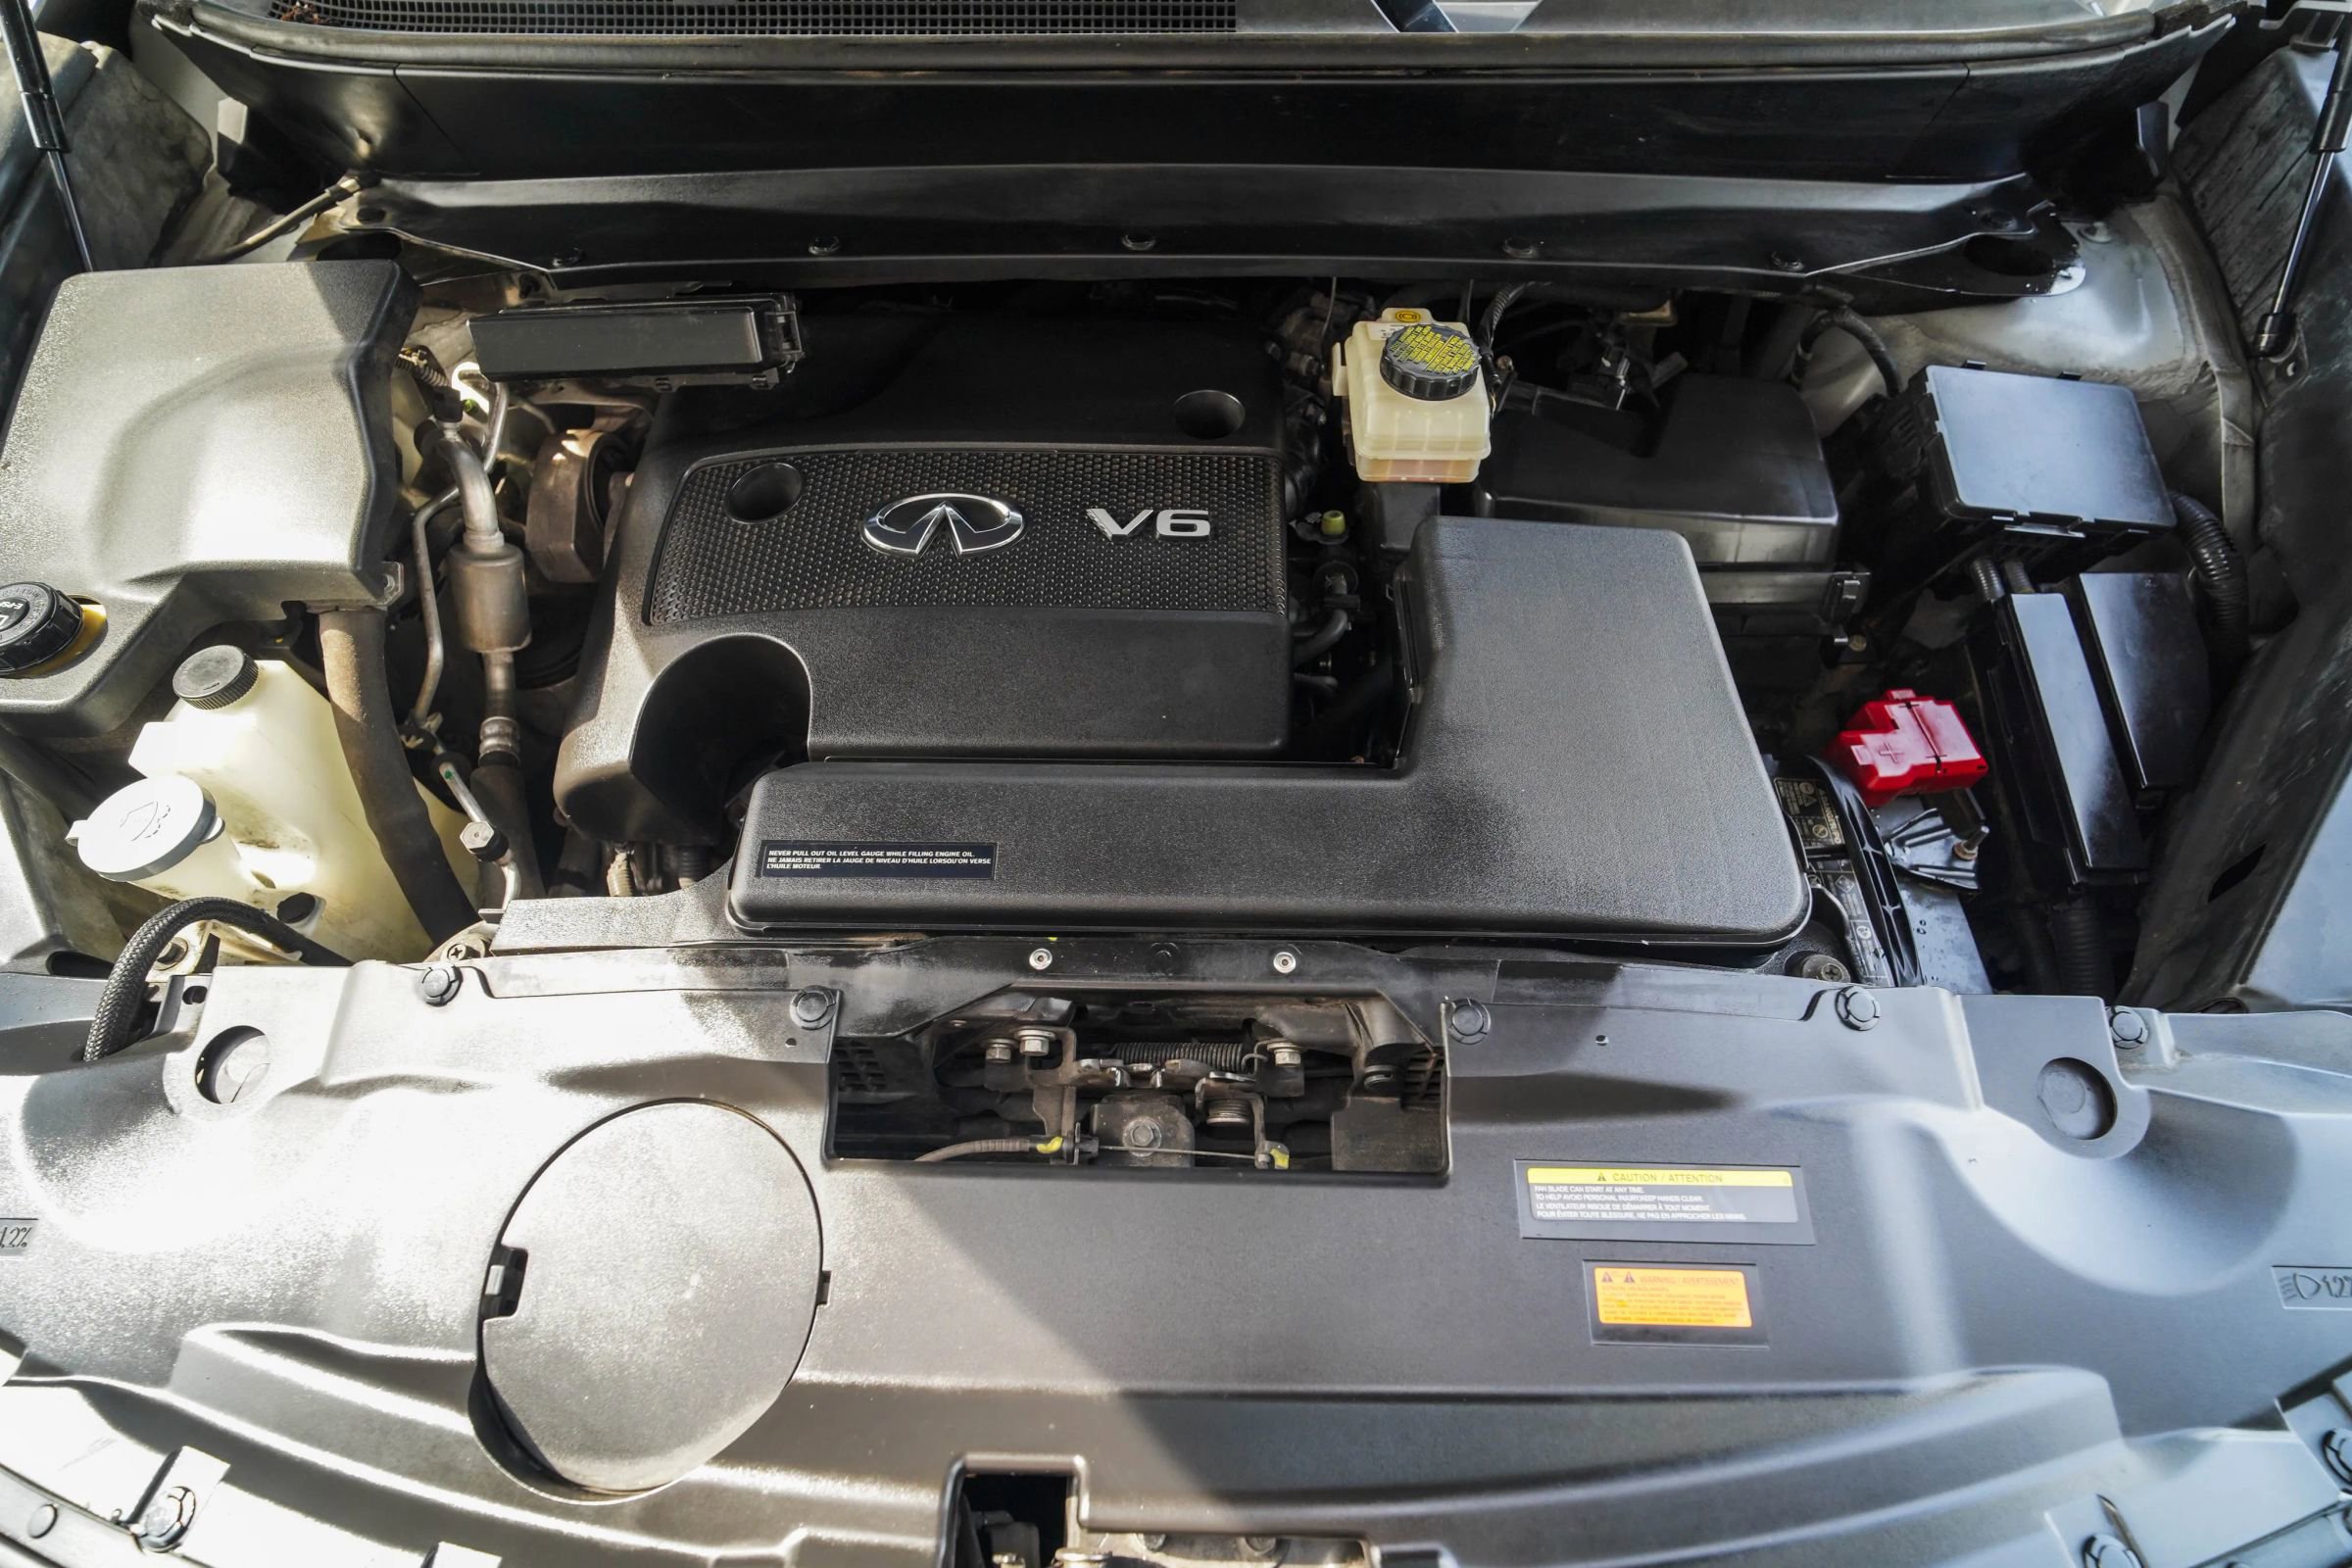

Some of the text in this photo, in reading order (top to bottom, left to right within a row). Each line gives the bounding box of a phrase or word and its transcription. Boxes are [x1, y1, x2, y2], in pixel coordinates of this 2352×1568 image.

[1085, 508, 1211, 539] V6
[1612, 1173, 1657, 1182] CAUTION
[1669, 1174, 1723, 1183] ATTENTION
